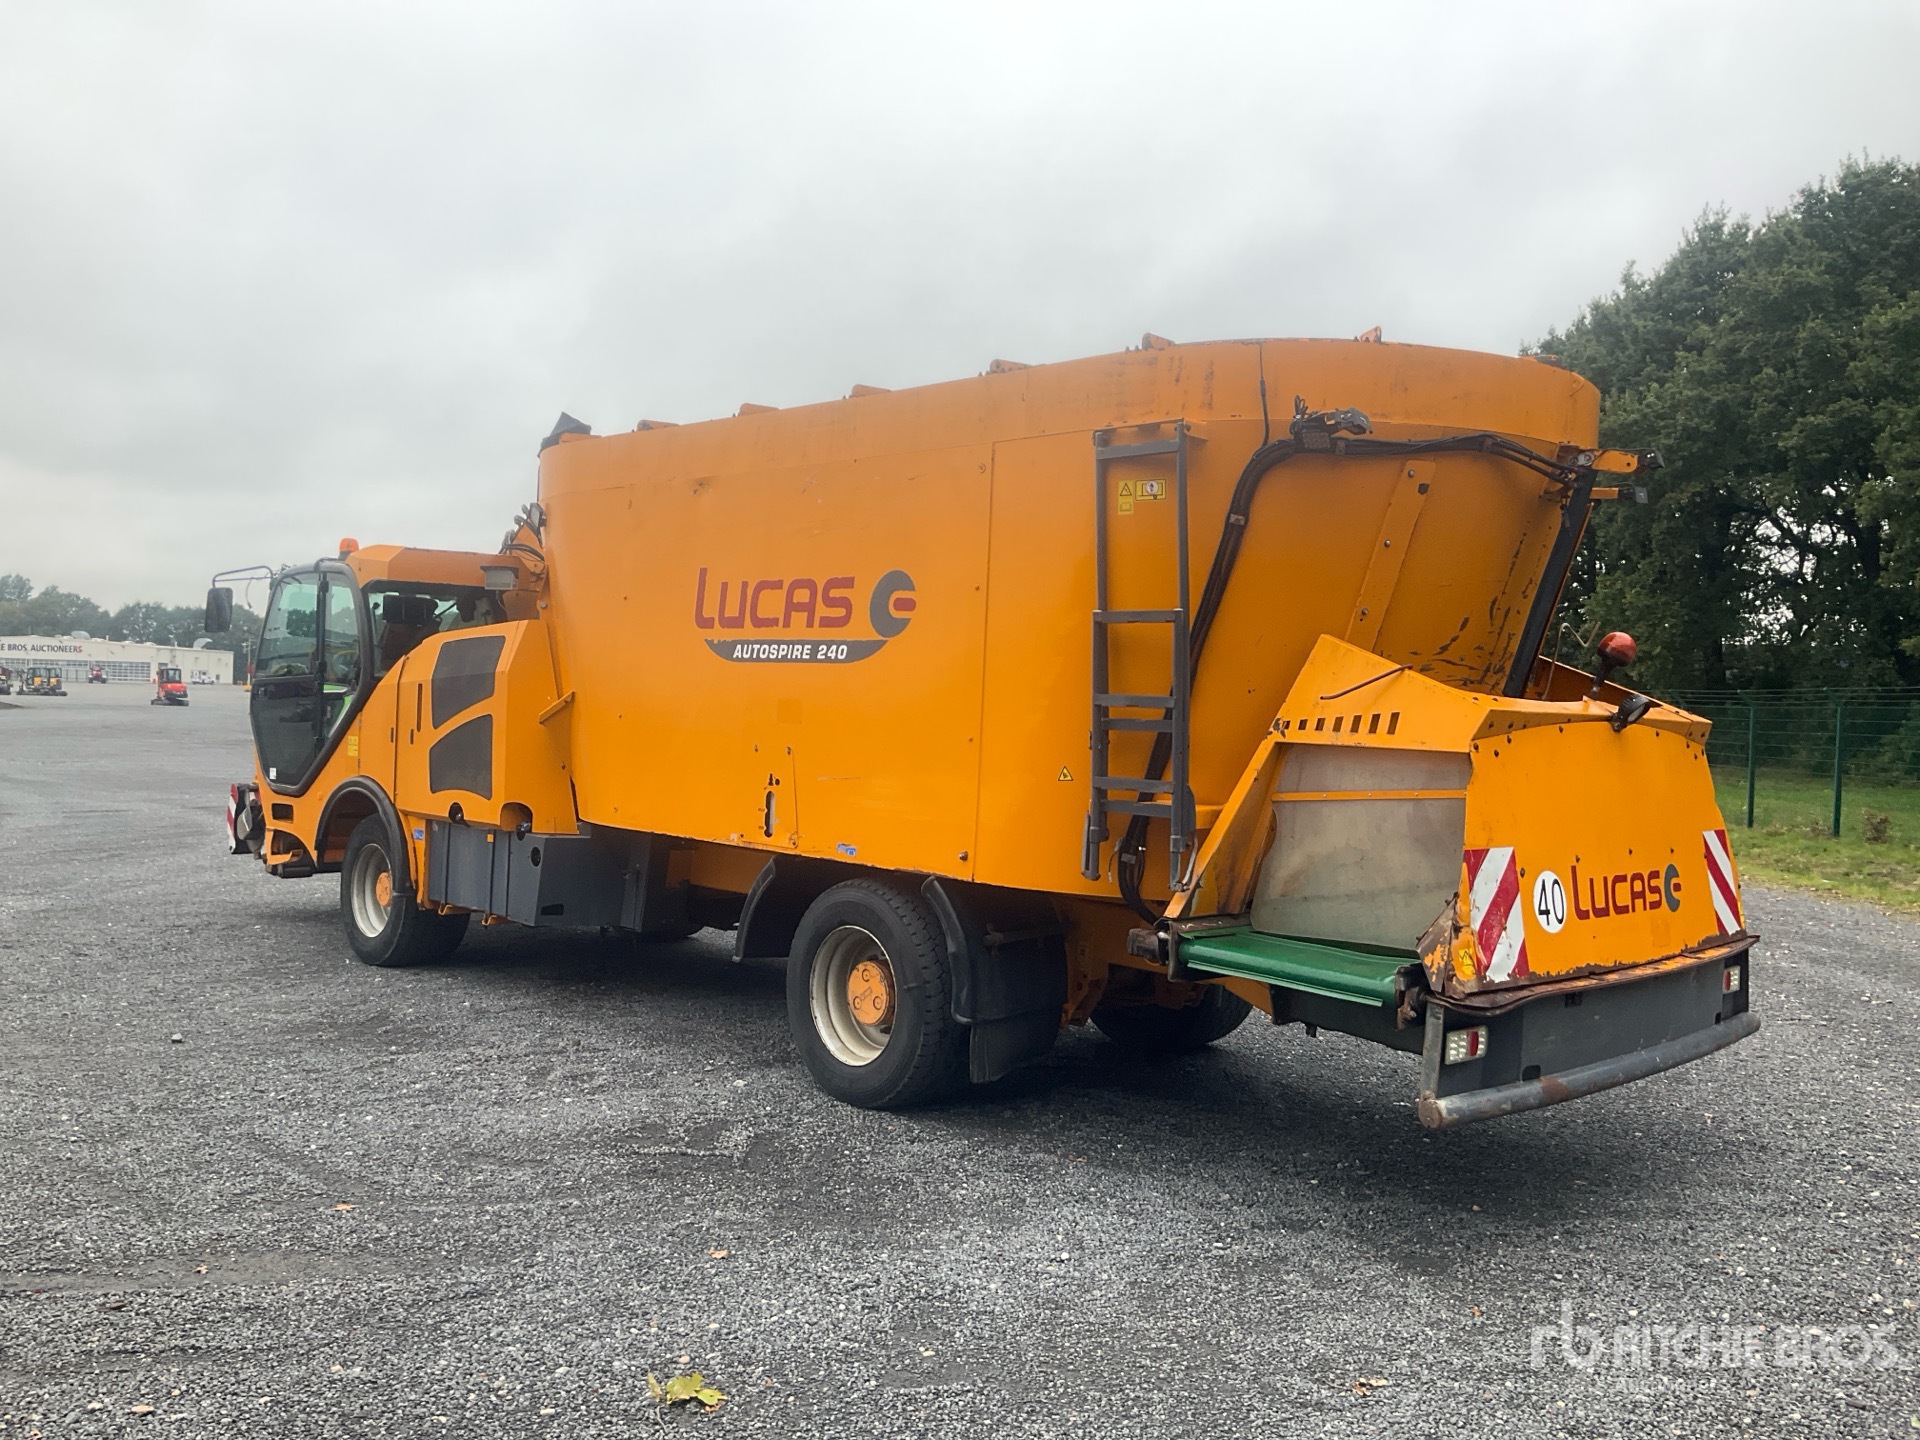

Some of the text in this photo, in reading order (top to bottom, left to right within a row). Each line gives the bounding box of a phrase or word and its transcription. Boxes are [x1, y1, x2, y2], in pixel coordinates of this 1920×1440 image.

[695, 567, 855, 629] LUCAS
[31, 645, 82, 653] AUCTIONEERS
[733, 644, 848, 659] AUTOSPIRE 240
[1538, 878, 1565, 926] 40
[1570, 865, 1663, 920] LUCAS
